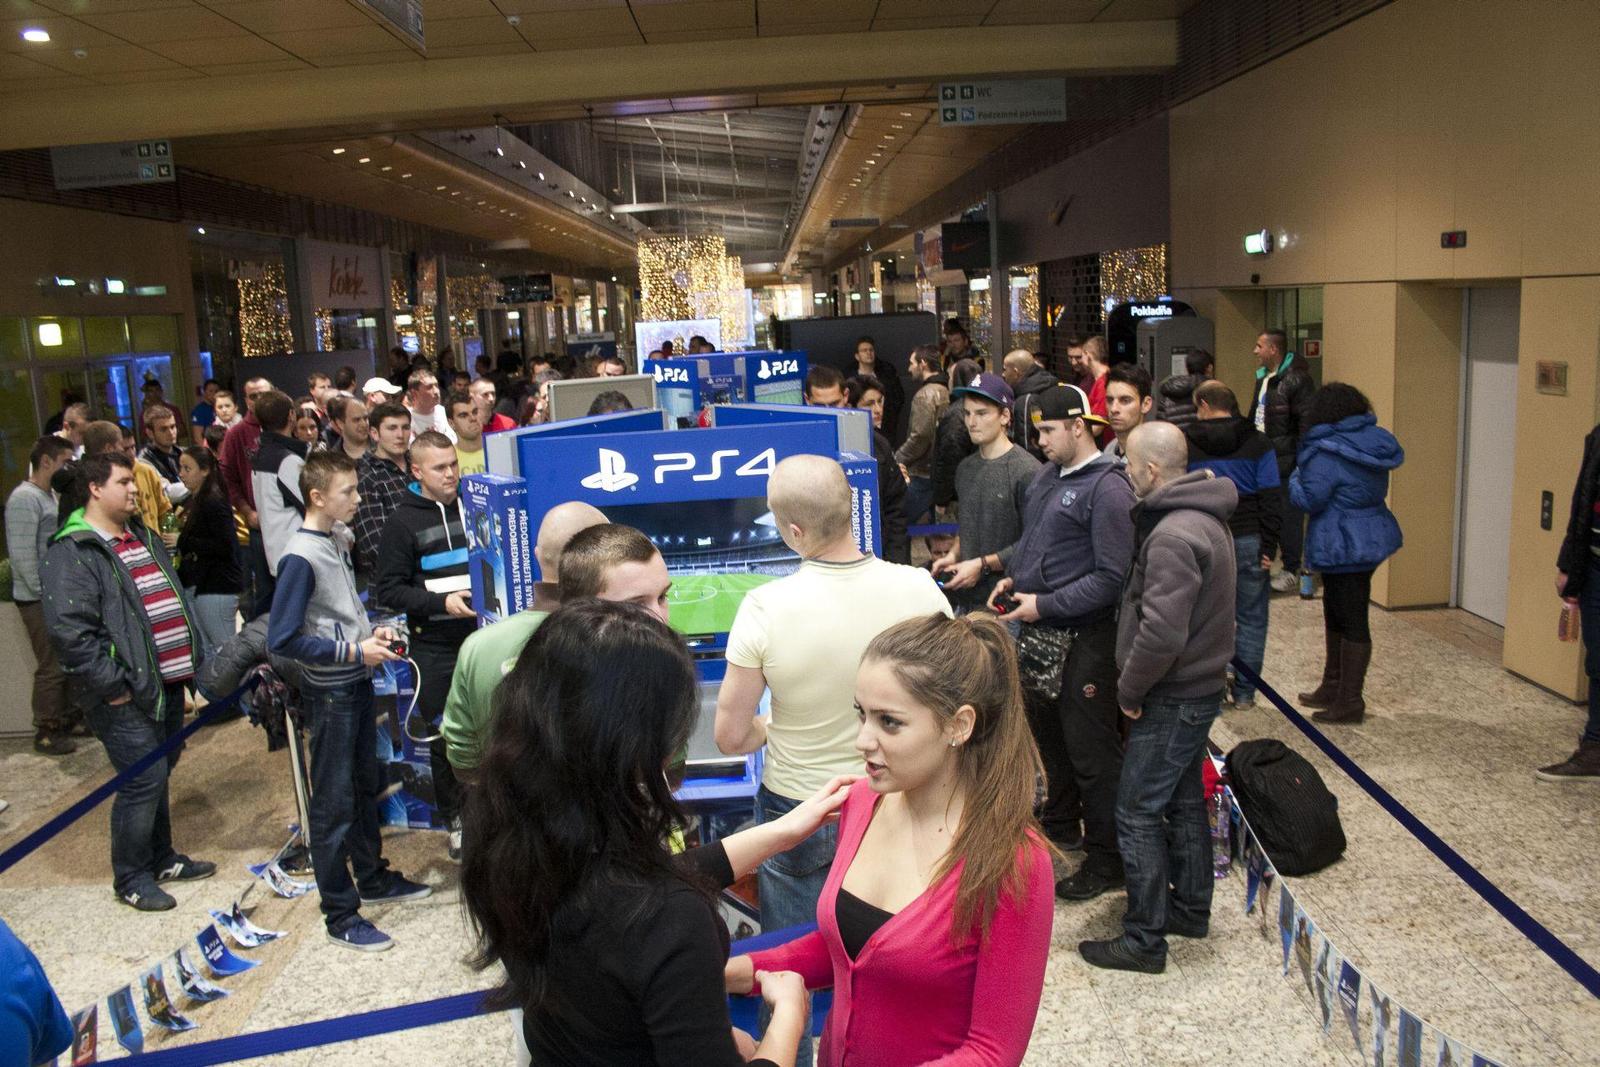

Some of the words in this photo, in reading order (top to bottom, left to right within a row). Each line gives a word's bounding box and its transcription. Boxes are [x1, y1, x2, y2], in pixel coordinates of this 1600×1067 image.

[976, 86, 992, 97] WC
[1130, 304, 1173, 317] Pokladňa
[664, 367, 689, 383] PS4
[771, 359, 799, 377] PS4
[652, 447, 777, 484] PS4
[474, 482, 490, 496] PS4
[507, 507, 521, 584] PREDOBJEDNAJTE
[514, 584, 524, 613] TERAZ
